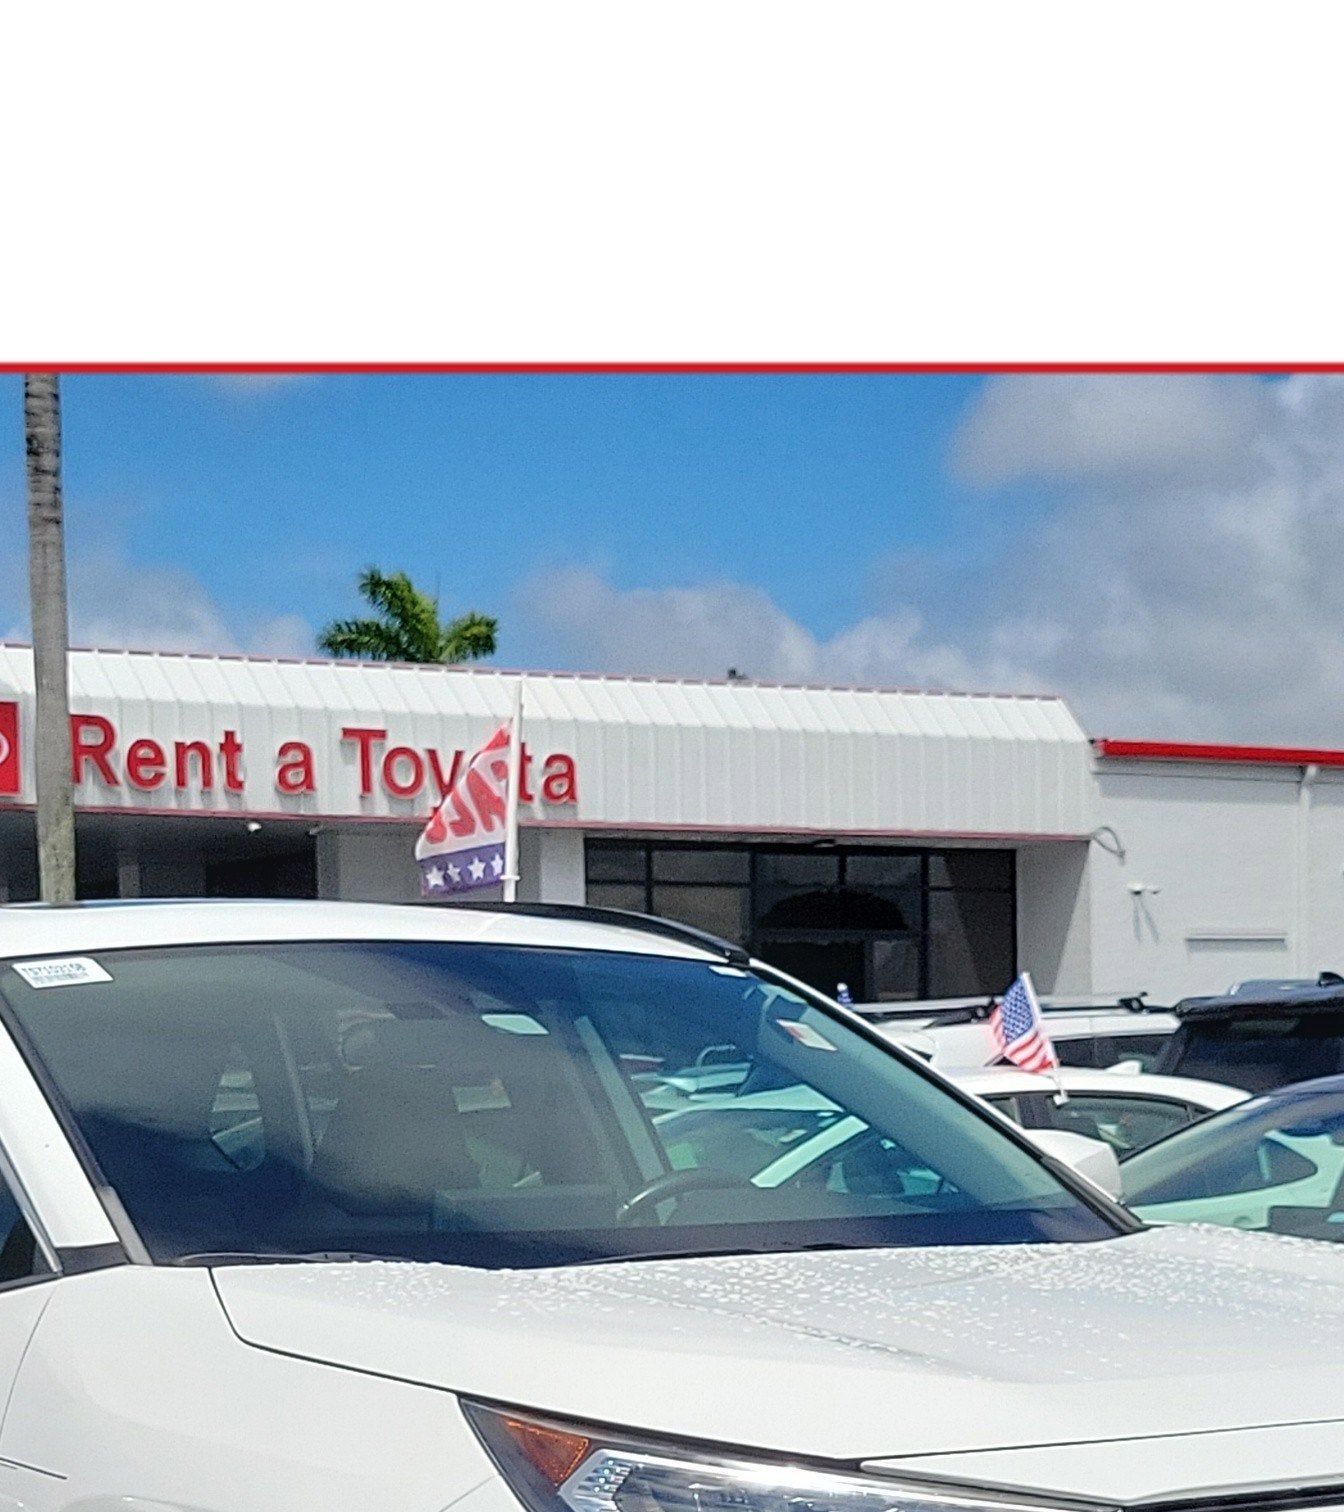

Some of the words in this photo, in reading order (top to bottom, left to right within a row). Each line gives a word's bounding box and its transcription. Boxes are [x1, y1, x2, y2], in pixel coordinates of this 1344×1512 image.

[69, 713, 246, 794] Rent
[276, 740, 316, 796] a
[341, 726, 578, 816] Toyta
